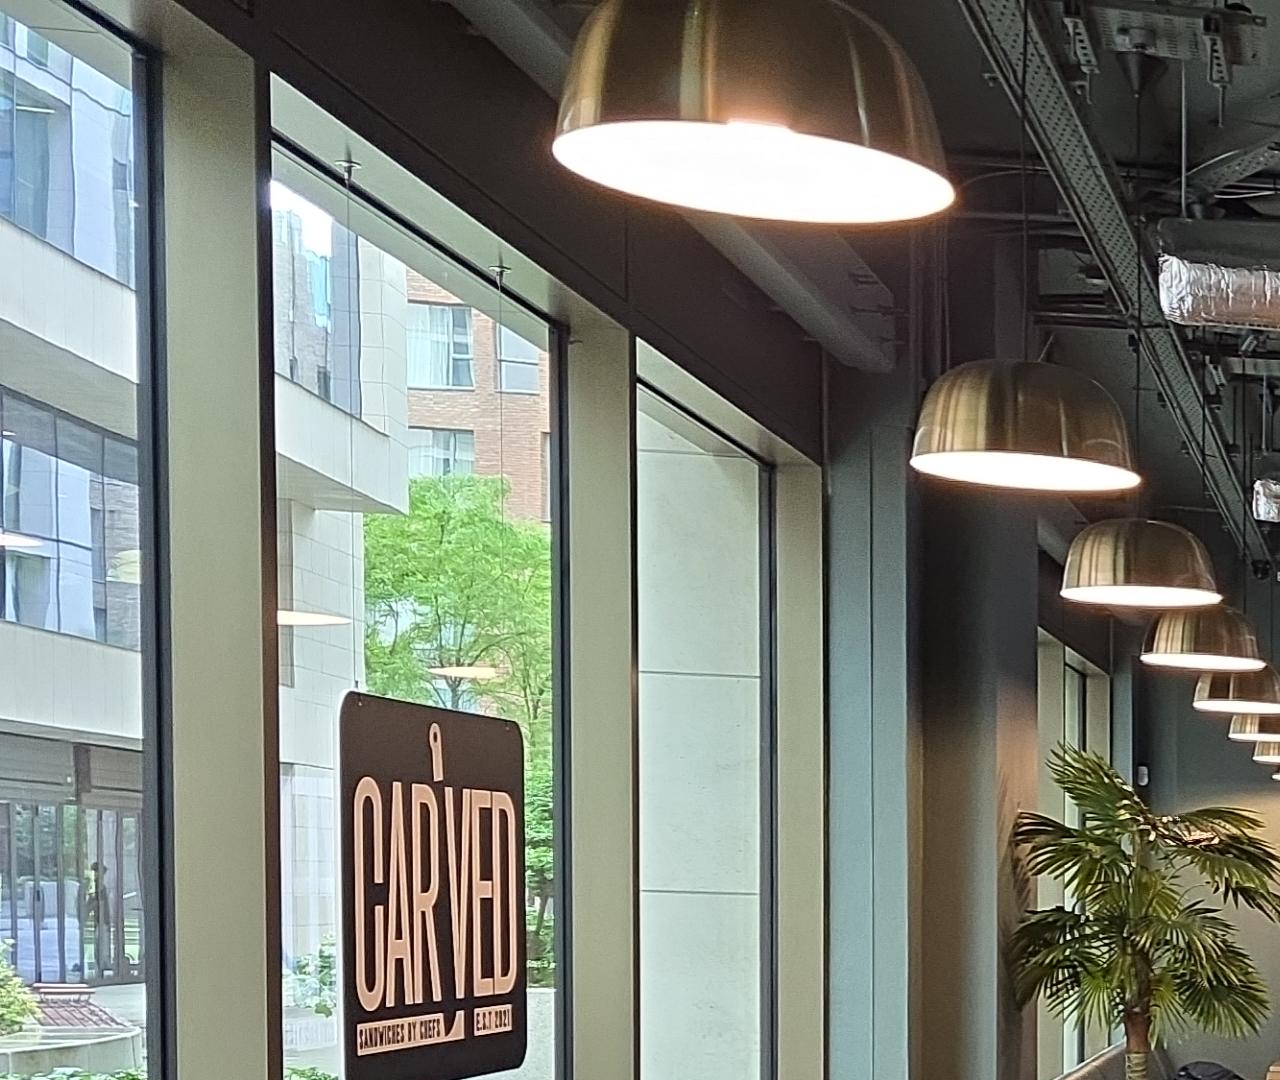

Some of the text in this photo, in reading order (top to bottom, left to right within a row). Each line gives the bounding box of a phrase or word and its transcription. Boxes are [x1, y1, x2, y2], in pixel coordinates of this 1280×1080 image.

[353, 776, 517, 1012] CARVED
[358, 1018, 441, 1051] SANDWICHES BY CHEFS
[475, 1009, 511, 1032] E.S.T 2021
